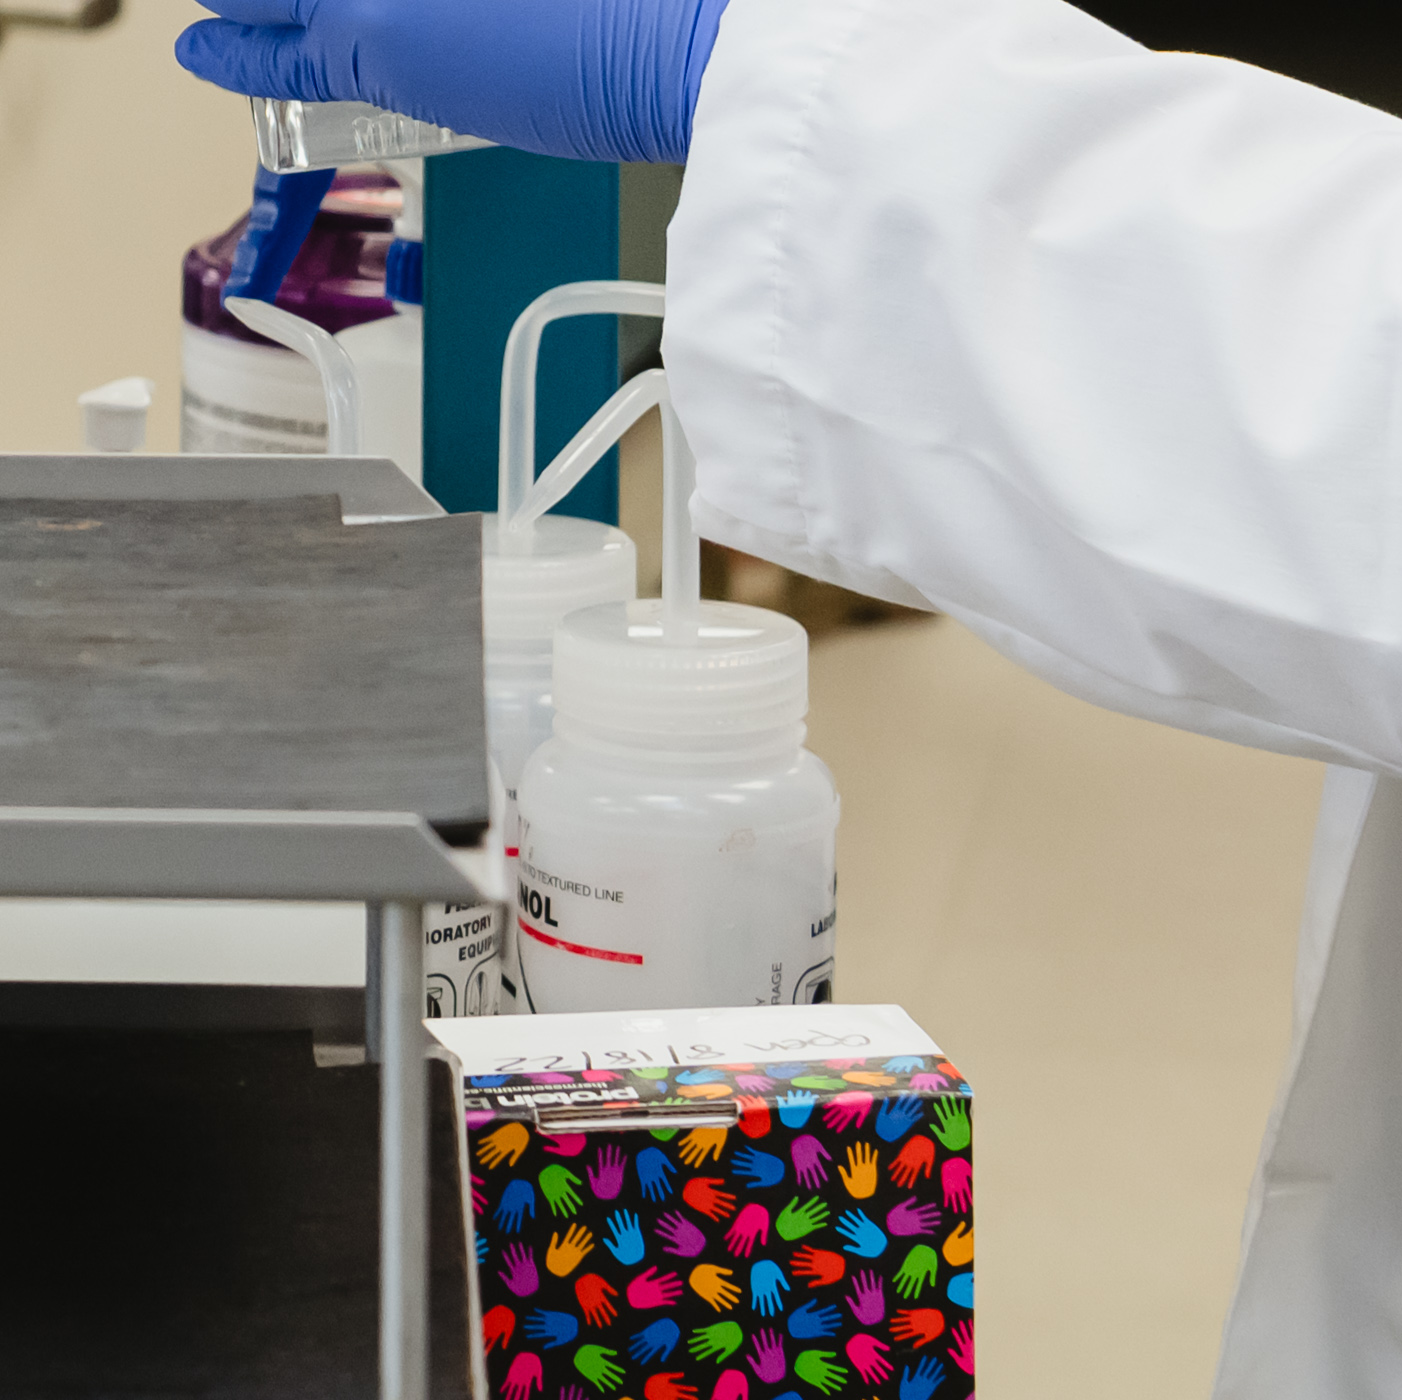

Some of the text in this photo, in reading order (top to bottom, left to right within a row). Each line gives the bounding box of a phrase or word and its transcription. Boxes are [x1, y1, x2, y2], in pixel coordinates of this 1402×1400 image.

[537, 868, 592, 898] TEXTURED
[594, 887, 625, 904] LINE
[517, 878, 559, 928] NOL
[458, 933, 499, 962] EQUIP
[497, 1086, 640, 1108] protein
